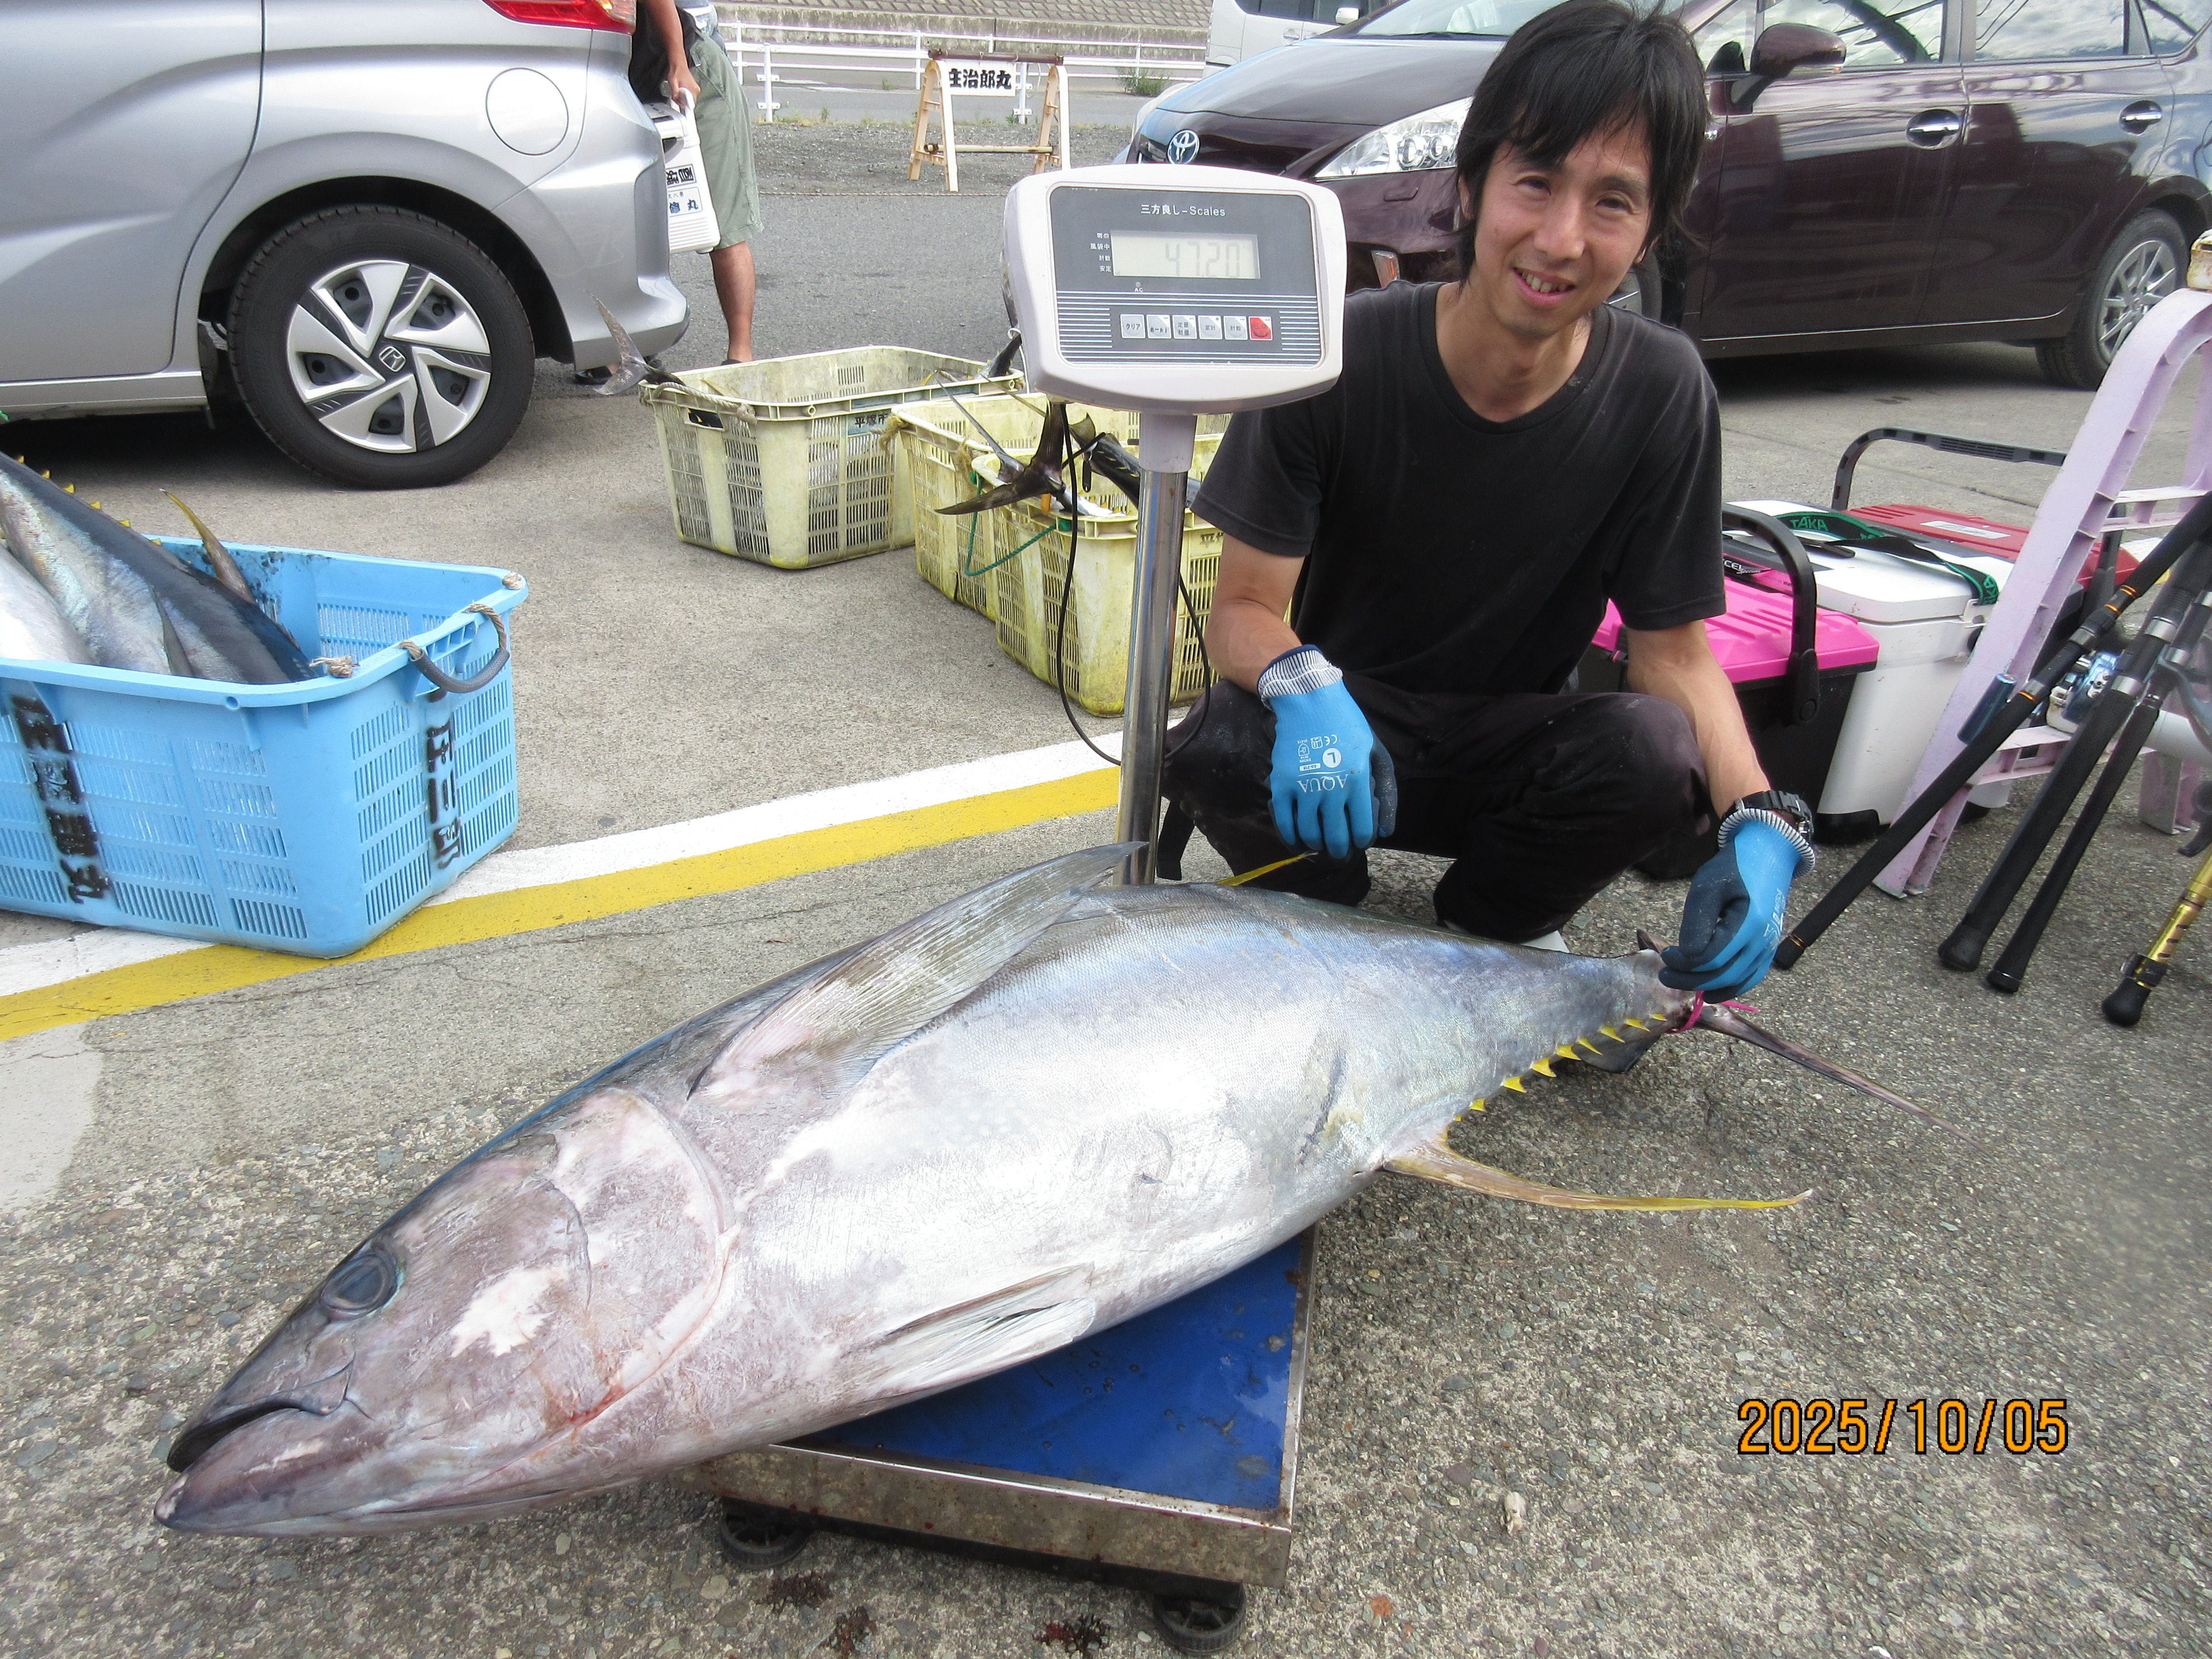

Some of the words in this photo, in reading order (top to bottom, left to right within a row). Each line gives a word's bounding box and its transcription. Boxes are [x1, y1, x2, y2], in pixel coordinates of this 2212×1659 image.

[1789, 516, 1829, 532] TAKA
[1722, 559, 1744, 571] CEL
[1327, 752, 1336, 763] L
[1297, 774, 1349, 793] AQUA
